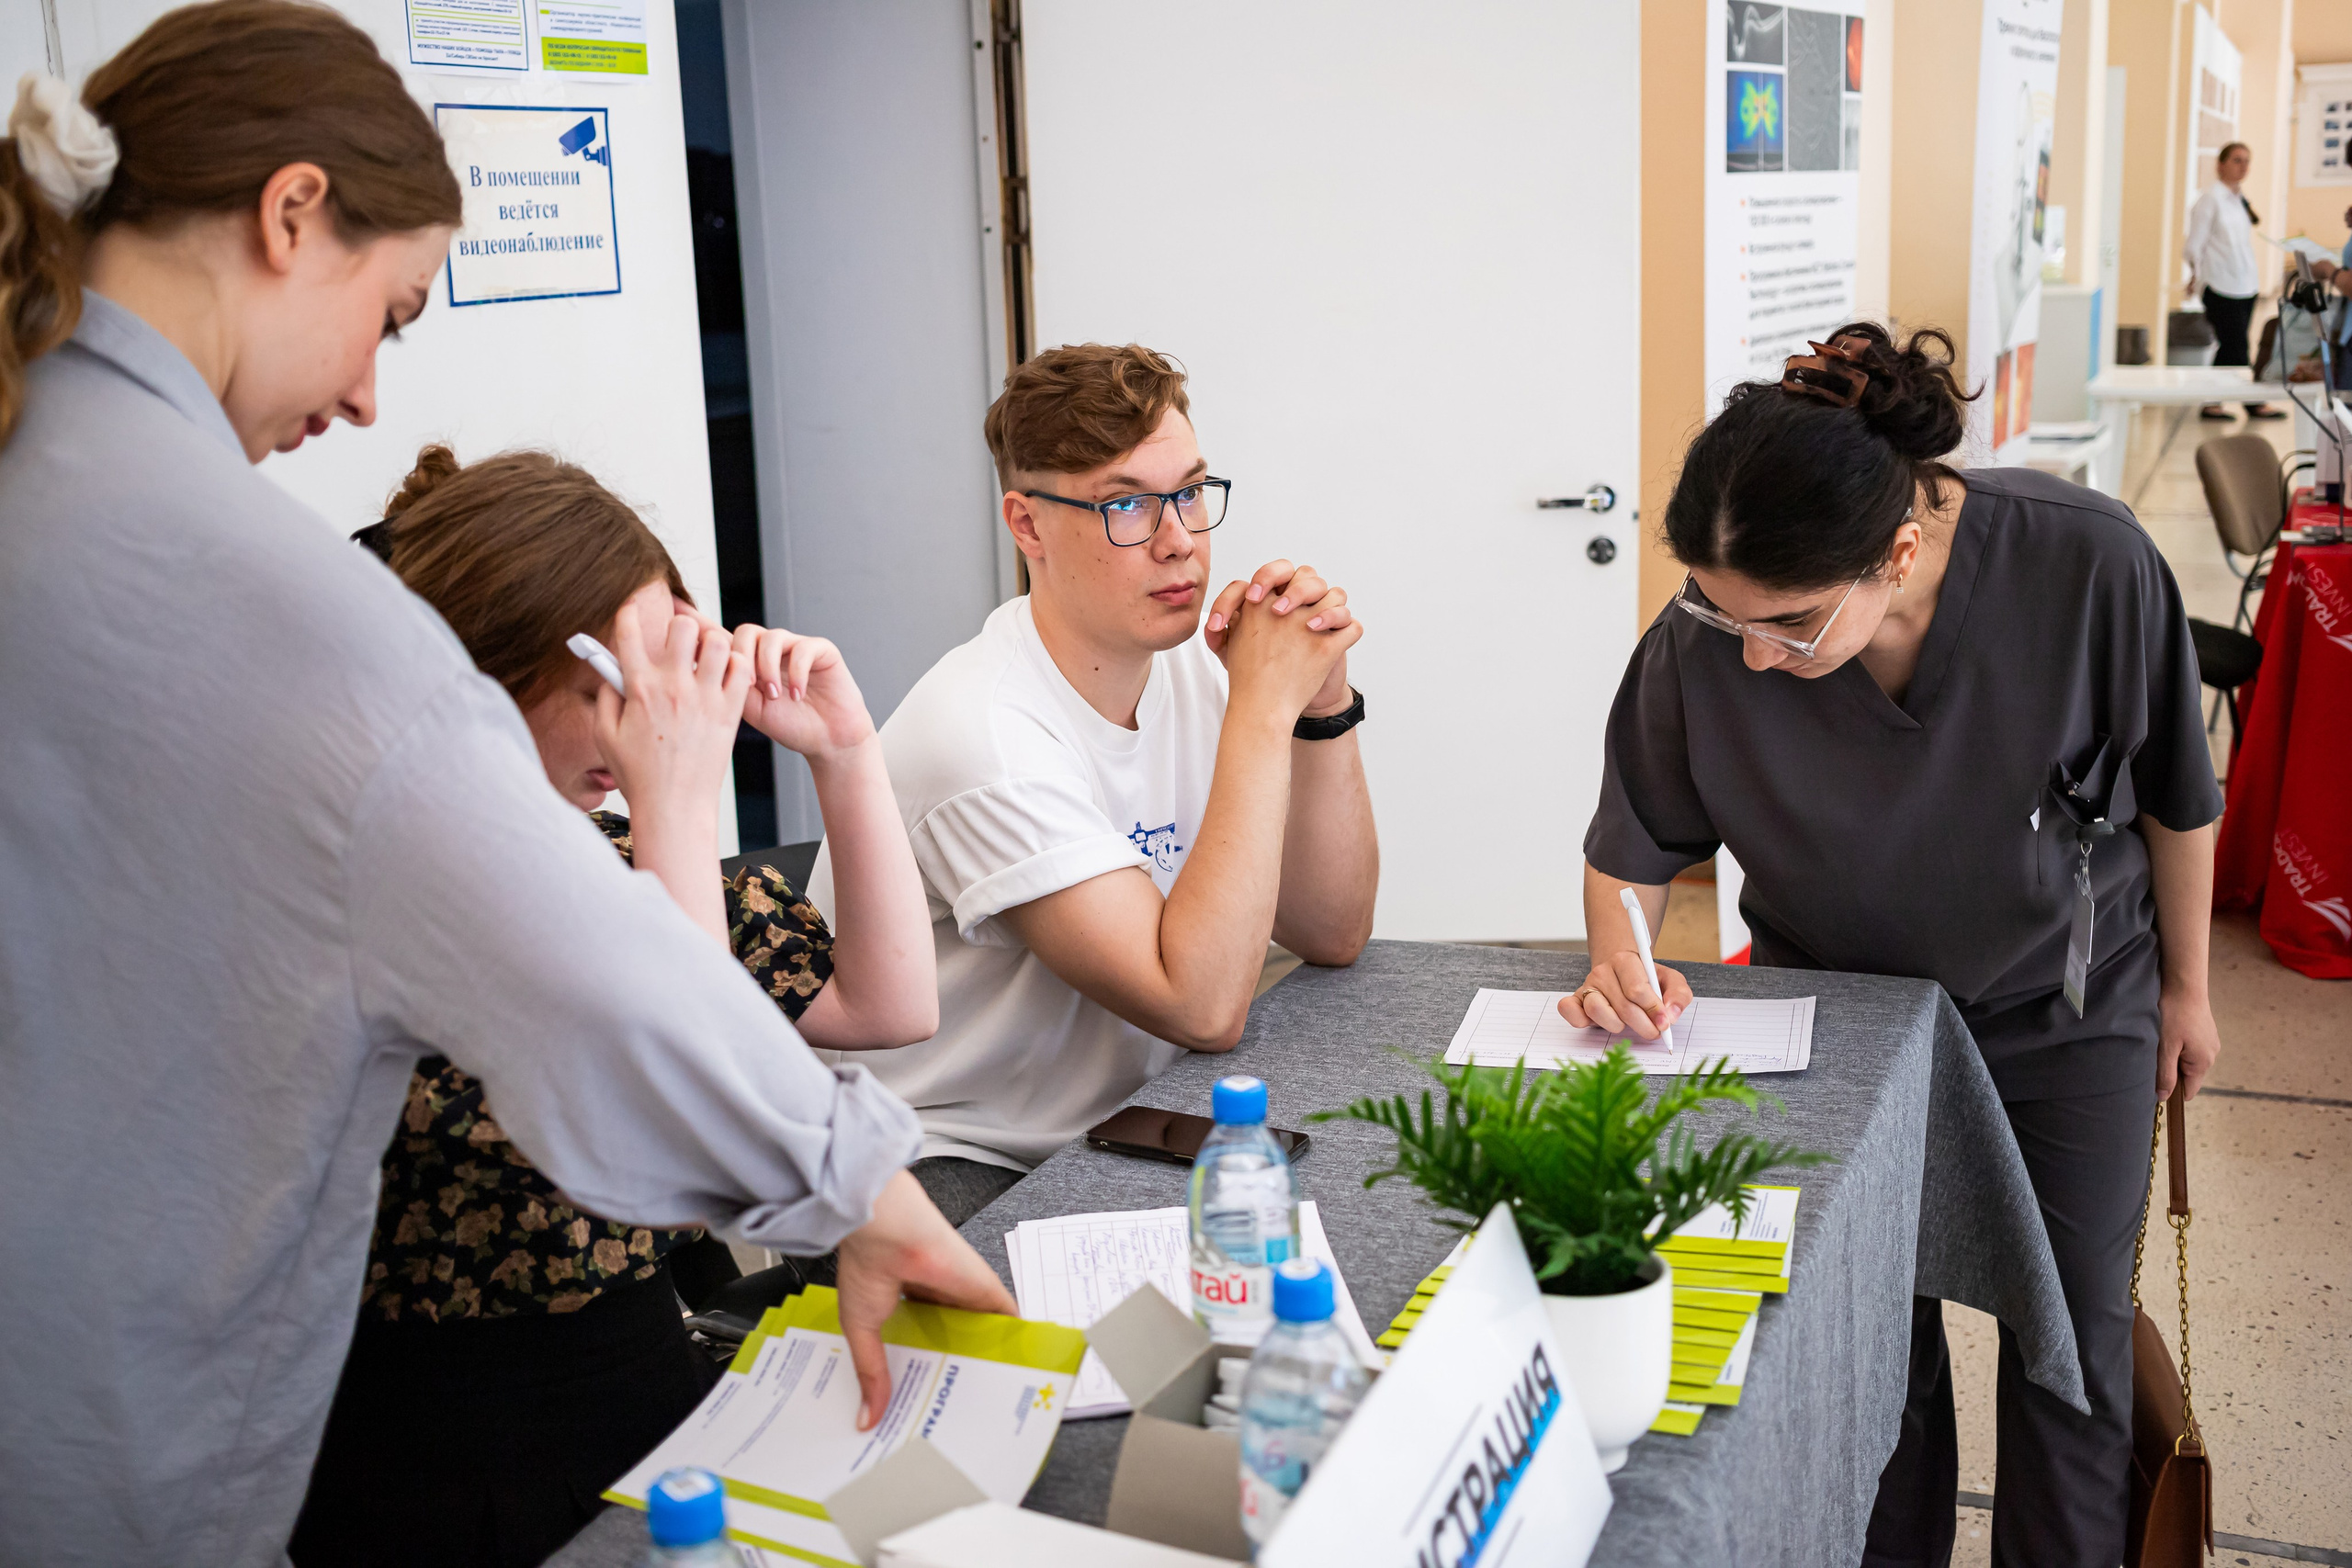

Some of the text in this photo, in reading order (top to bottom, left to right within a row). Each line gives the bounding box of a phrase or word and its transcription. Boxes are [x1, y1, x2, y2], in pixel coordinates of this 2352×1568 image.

[469, 165, 581, 187] В помещении
[499, 199, 559, 220] ведётся
[459, 231, 604, 256] видеонаблюдение
[1419, 1342, 1559, 1568] СТРАЦИЯ
